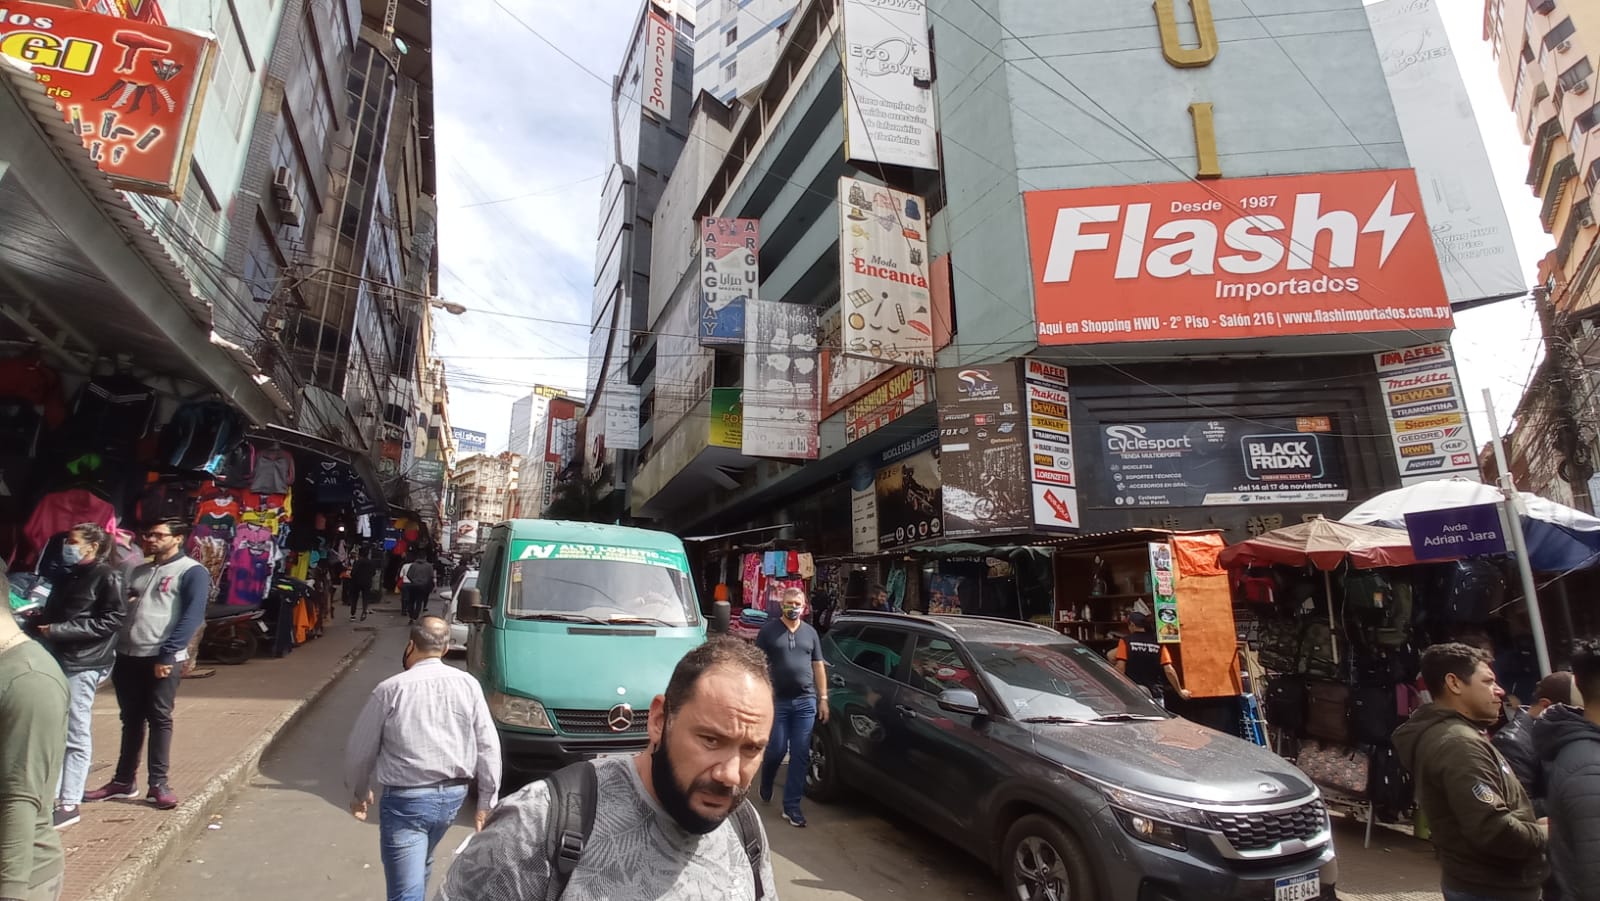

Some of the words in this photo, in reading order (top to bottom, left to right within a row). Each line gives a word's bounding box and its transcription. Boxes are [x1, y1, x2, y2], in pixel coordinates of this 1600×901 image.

[849, 43, 890, 62] ECO
[880, 62, 930, 80] POWER
[1171, 200, 1222, 213] Desde
[1240, 196, 1277, 209] 1987
[1043, 193, 1358, 283] Flash
[871, 255, 897, 268] Moda
[703, 218, 718, 336] PARAGUAY
[855, 257, 928, 289] Encanta
[1216, 275, 1359, 300] Importados
[1066, 323, 1078, 333] en
[1082, 318, 1131, 334] Shopping
[1134, 317, 1160, 330] HWU
[1186, 315, 1209, 328] Piso
[1220, 313, 1250, 327] Salón
[1254, 312, 1274, 326] 216
[1283, 305, 1450, 325] www.flashimportados.com.py
[888, 367, 914, 399] SHOP
[1397, 402, 1453, 416] TRAMONTINA
[1037, 418, 1065, 429] STANLEY
[940, 428, 958, 437] FOX
[1035, 432, 1069, 441] TRAMONTINA
[1401, 431, 1440, 442] GEDORE
[1108, 434, 1191, 453] Cyclesport
[1249, 441, 1309, 456] BLACK
[1402, 445, 1431, 454] IRWIN
[1251, 454, 1313, 470] FRIDAY
[1409, 459, 1440, 468] NORTON
[1453, 457, 1470, 465] 3M
[1290, 482, 1332, 490] noviembre
[1442, 523, 1468, 533] Avda
[1424, 535, 1464, 547] Adrian
[1467, 531, 1496, 542] Jara
[560, 543, 595, 553] ALTO
[1301, 881, 1315, 897] 843
